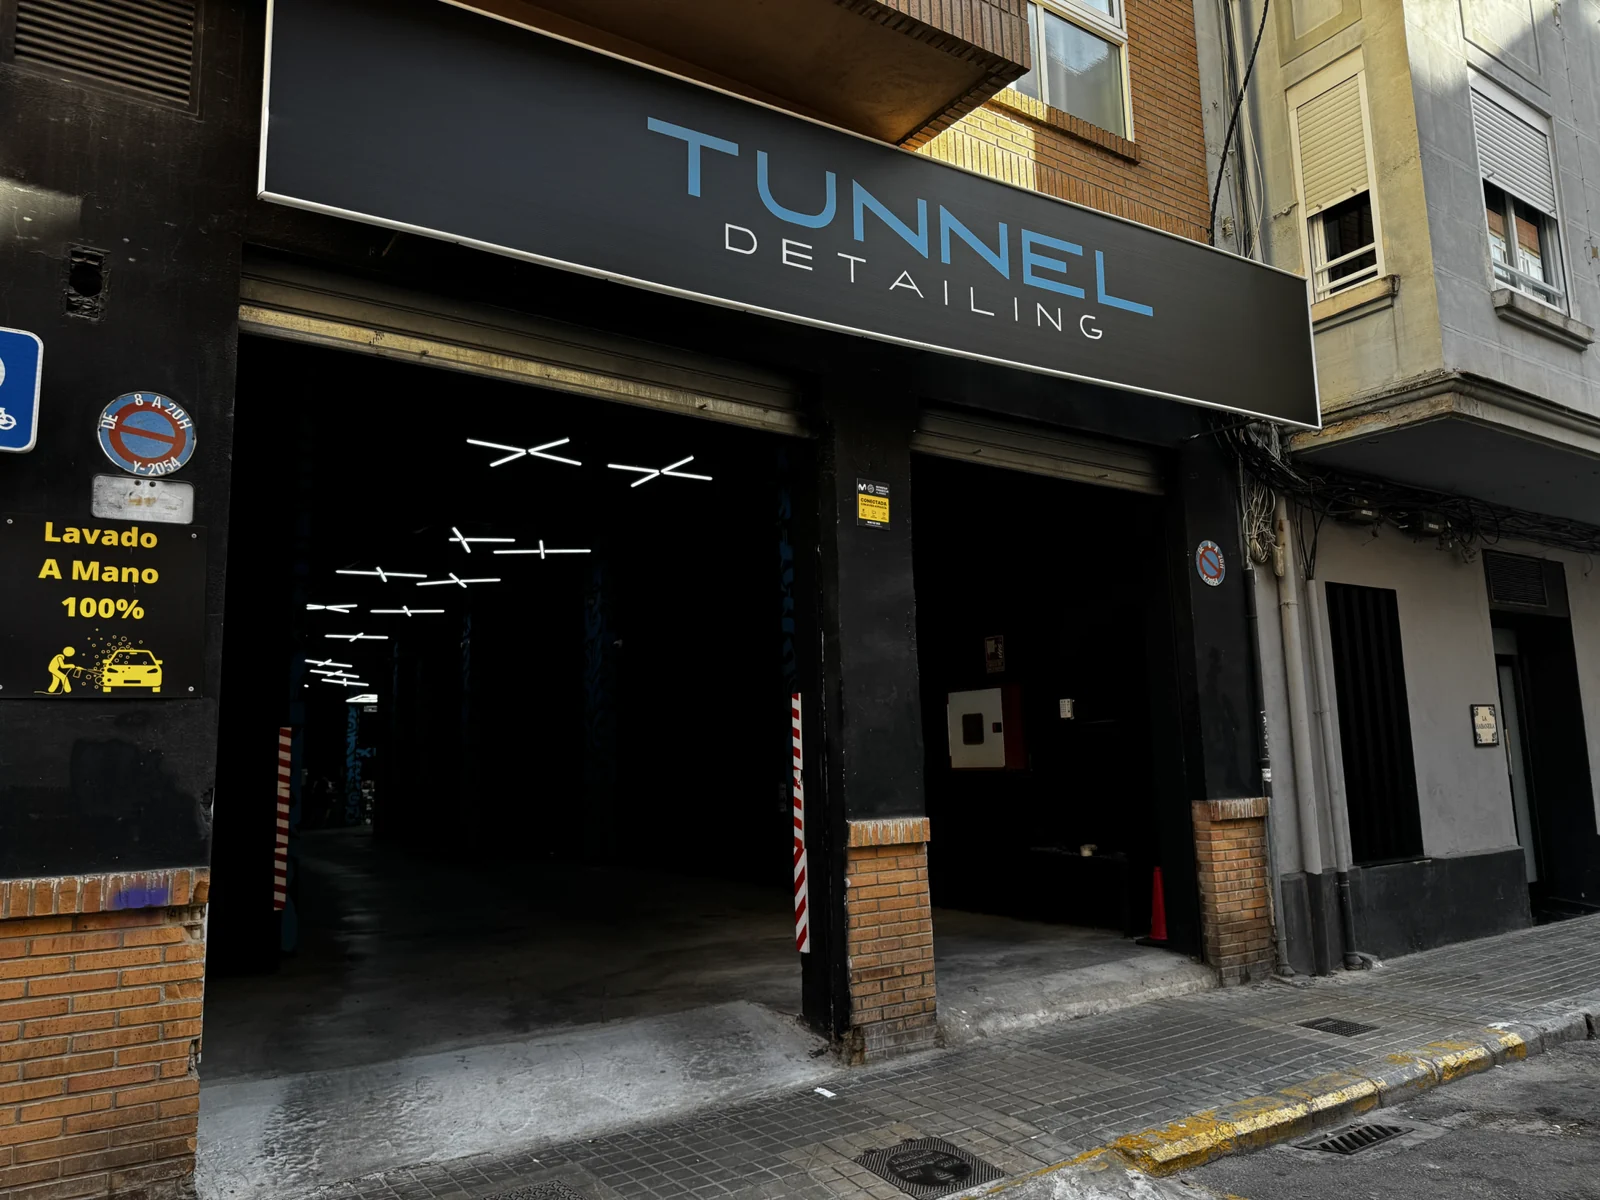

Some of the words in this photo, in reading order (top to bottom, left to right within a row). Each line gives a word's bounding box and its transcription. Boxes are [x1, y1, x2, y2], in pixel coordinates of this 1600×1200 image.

[647, 116, 1154, 317] TUNNEL
[725, 222, 1104, 340] DETAILING
[101, 412, 119, 430] DE
[134, 393, 144, 406] 8
[151, 396, 162, 409] A
[164, 402, 192, 430] 20H
[132, 456, 181, 476] Y-2054
[44, 521, 158, 548] Lavado
[38, 558, 62, 580] A
[72, 559, 159, 584] Mano
[61, 596, 145, 620] 100%
